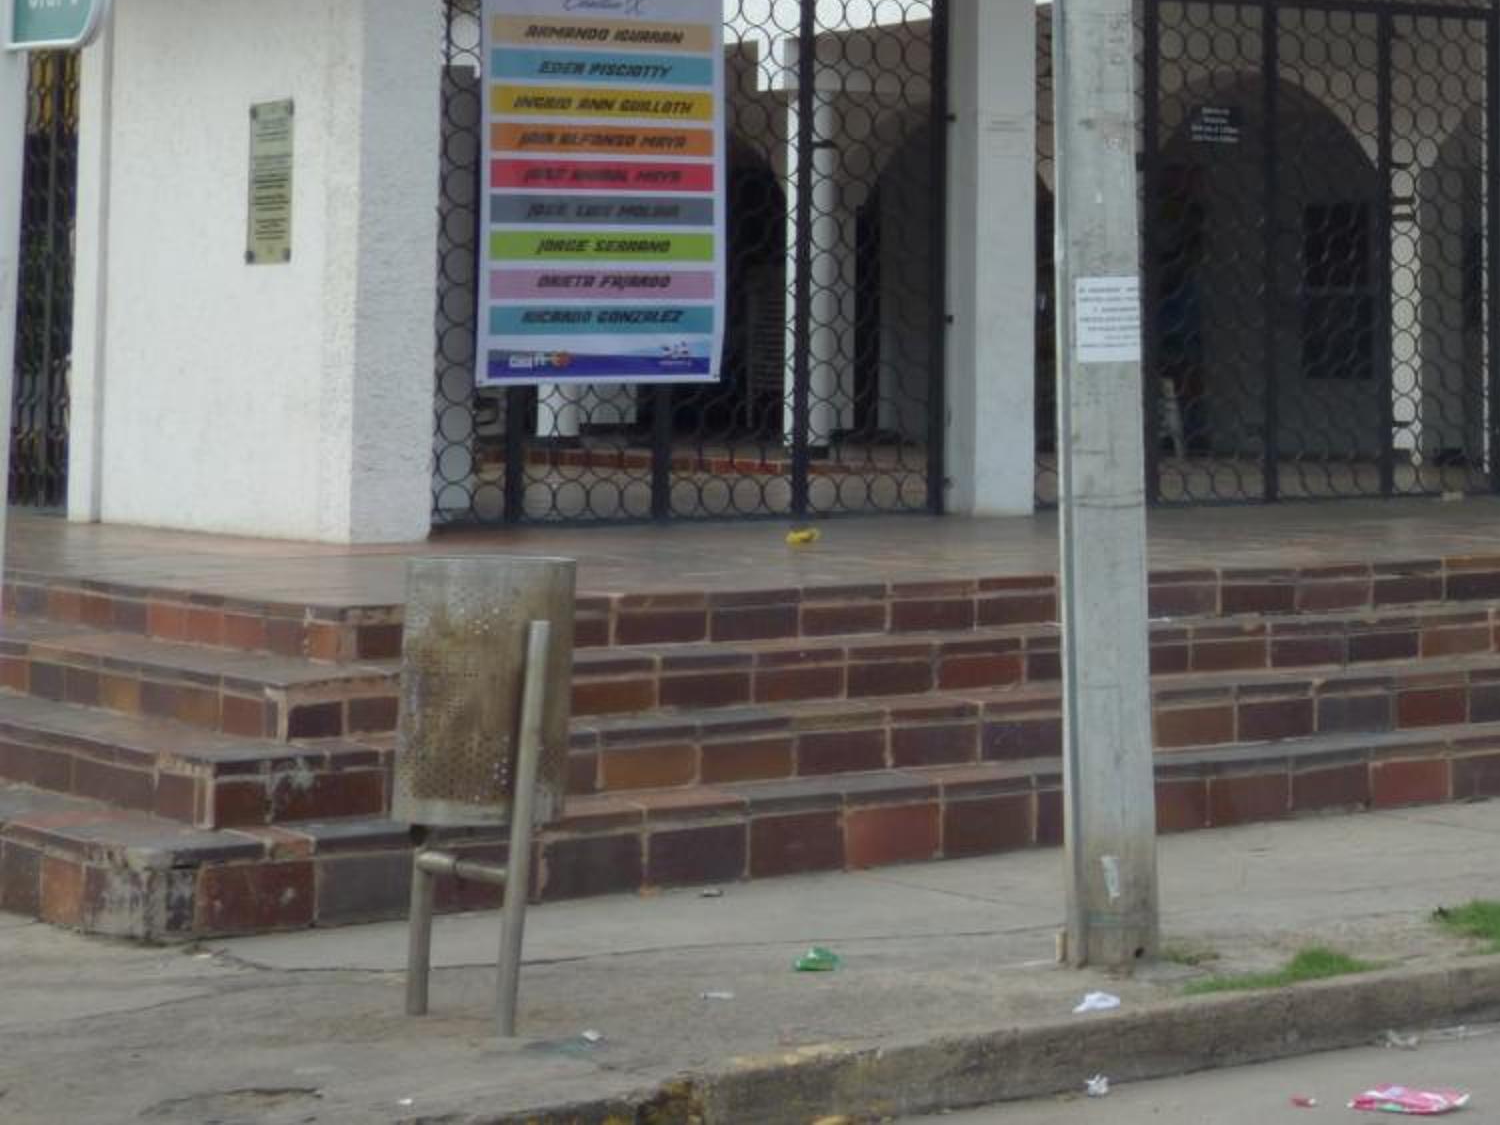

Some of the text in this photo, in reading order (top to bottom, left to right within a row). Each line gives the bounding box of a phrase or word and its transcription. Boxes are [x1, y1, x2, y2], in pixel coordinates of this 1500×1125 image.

[525, 24, 610, 42] ARMANDO
[535, 239, 672, 255] JORGE SERRANO
[597, 309, 684, 324] GONZALEZ
